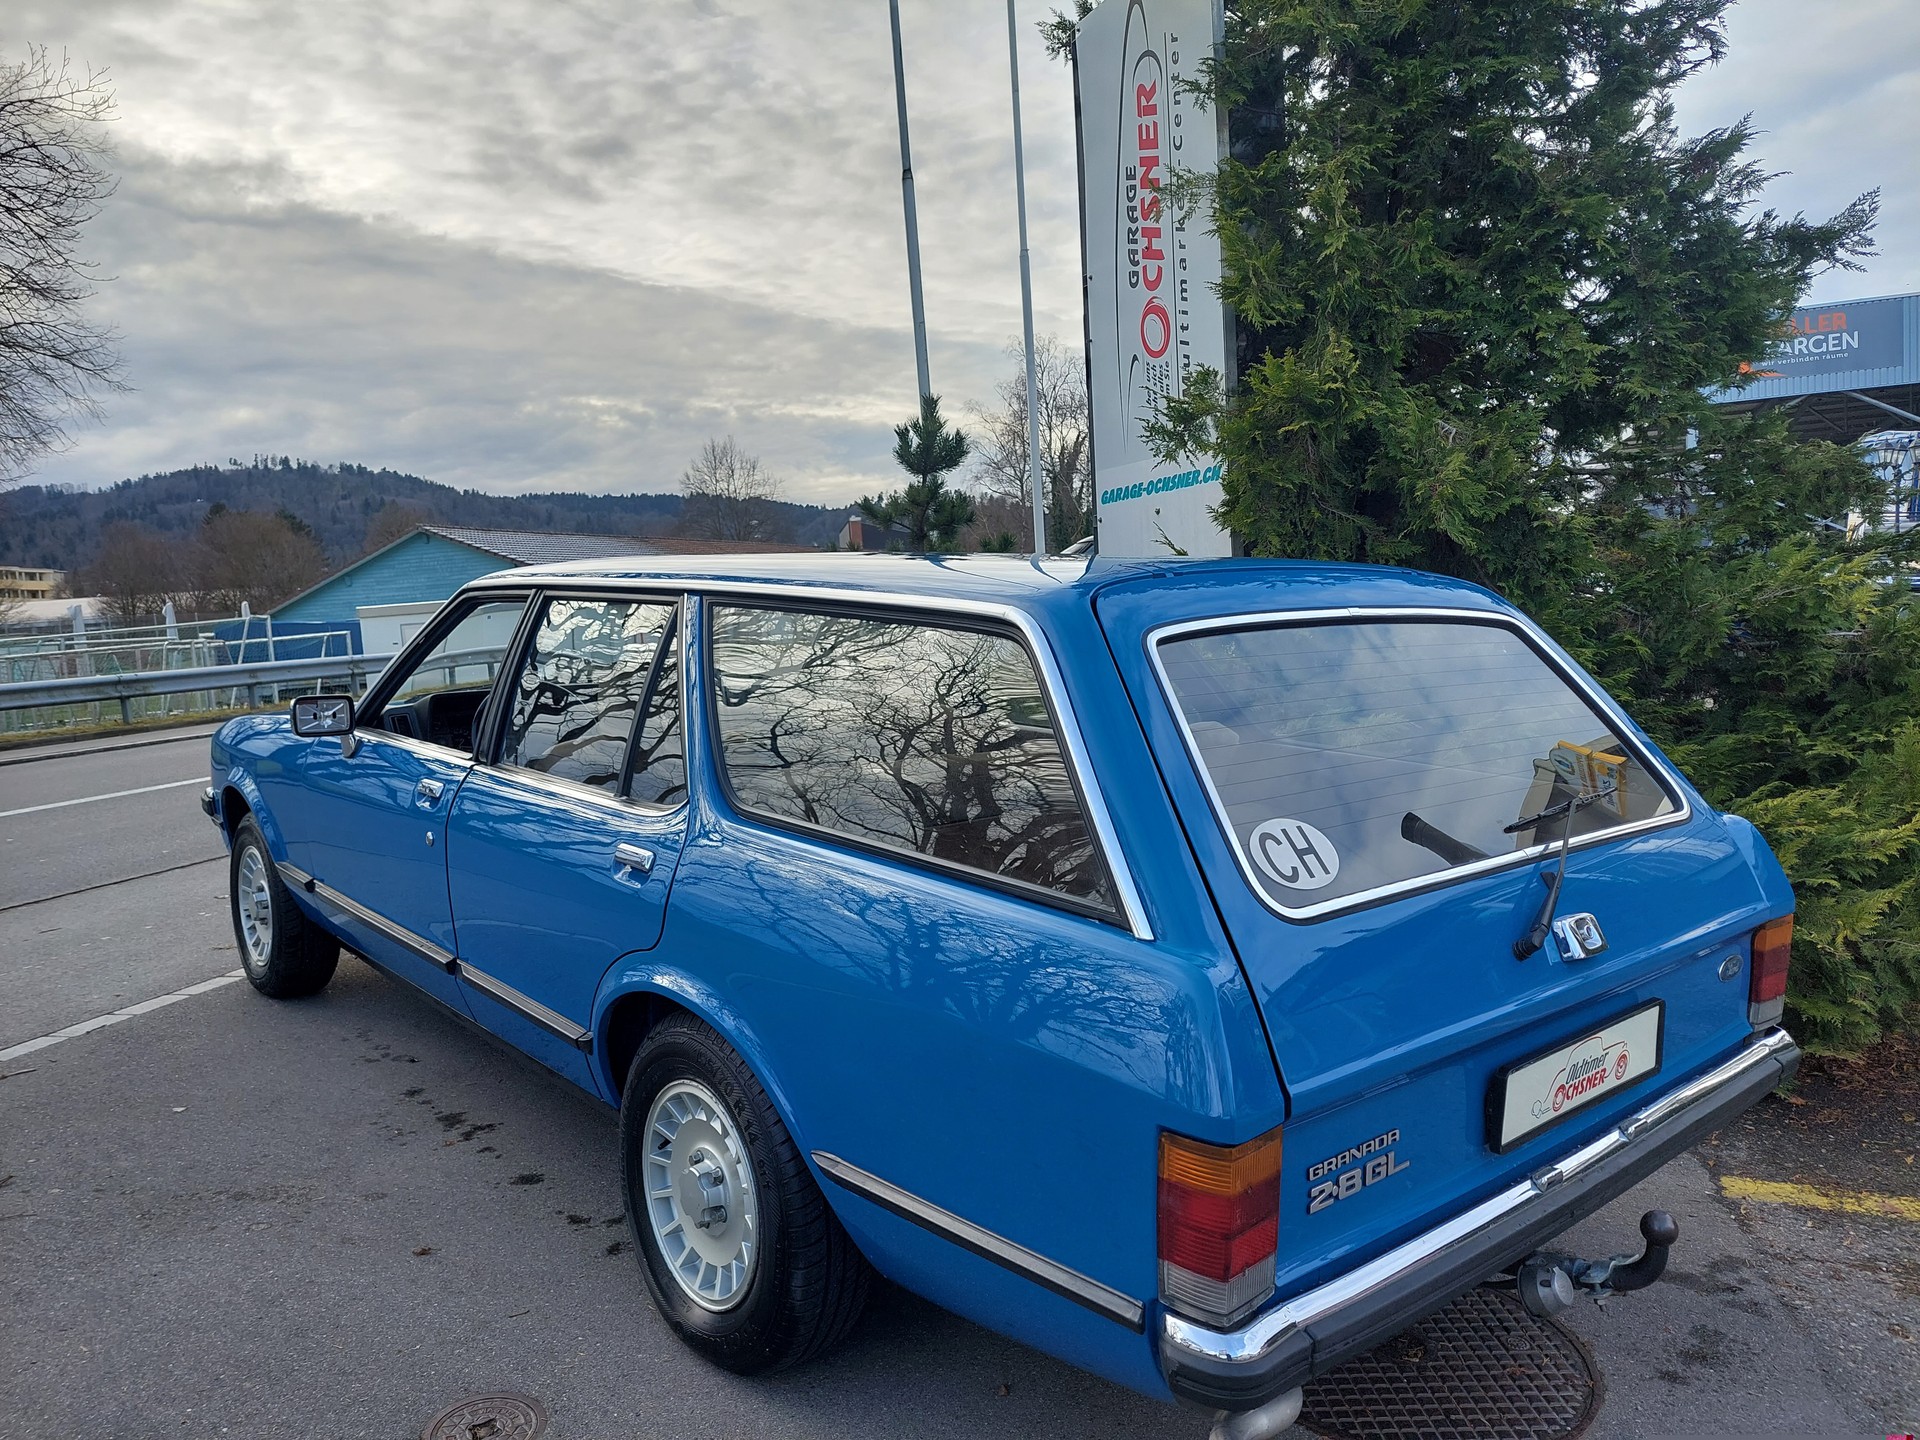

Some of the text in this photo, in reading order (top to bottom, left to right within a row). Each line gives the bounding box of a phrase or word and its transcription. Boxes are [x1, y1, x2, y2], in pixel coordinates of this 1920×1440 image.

[1126, 165, 1139, 289] GARAGE
[1136, 79, 1171, 358] OCHSNER
[1778, 356, 1820, 365] verbinden
[1822, 352, 1849, 360] räume
[1101, 464, 1222, 505] GARAGE-OCHSNER.CH
[1259, 825, 1331, 883] CH
[1553, 1067, 1607, 1112] OCHSNER
[1566, 1051, 1610, 1084] Oldtimer
[1308, 1129, 1400, 1181] GRANADA
